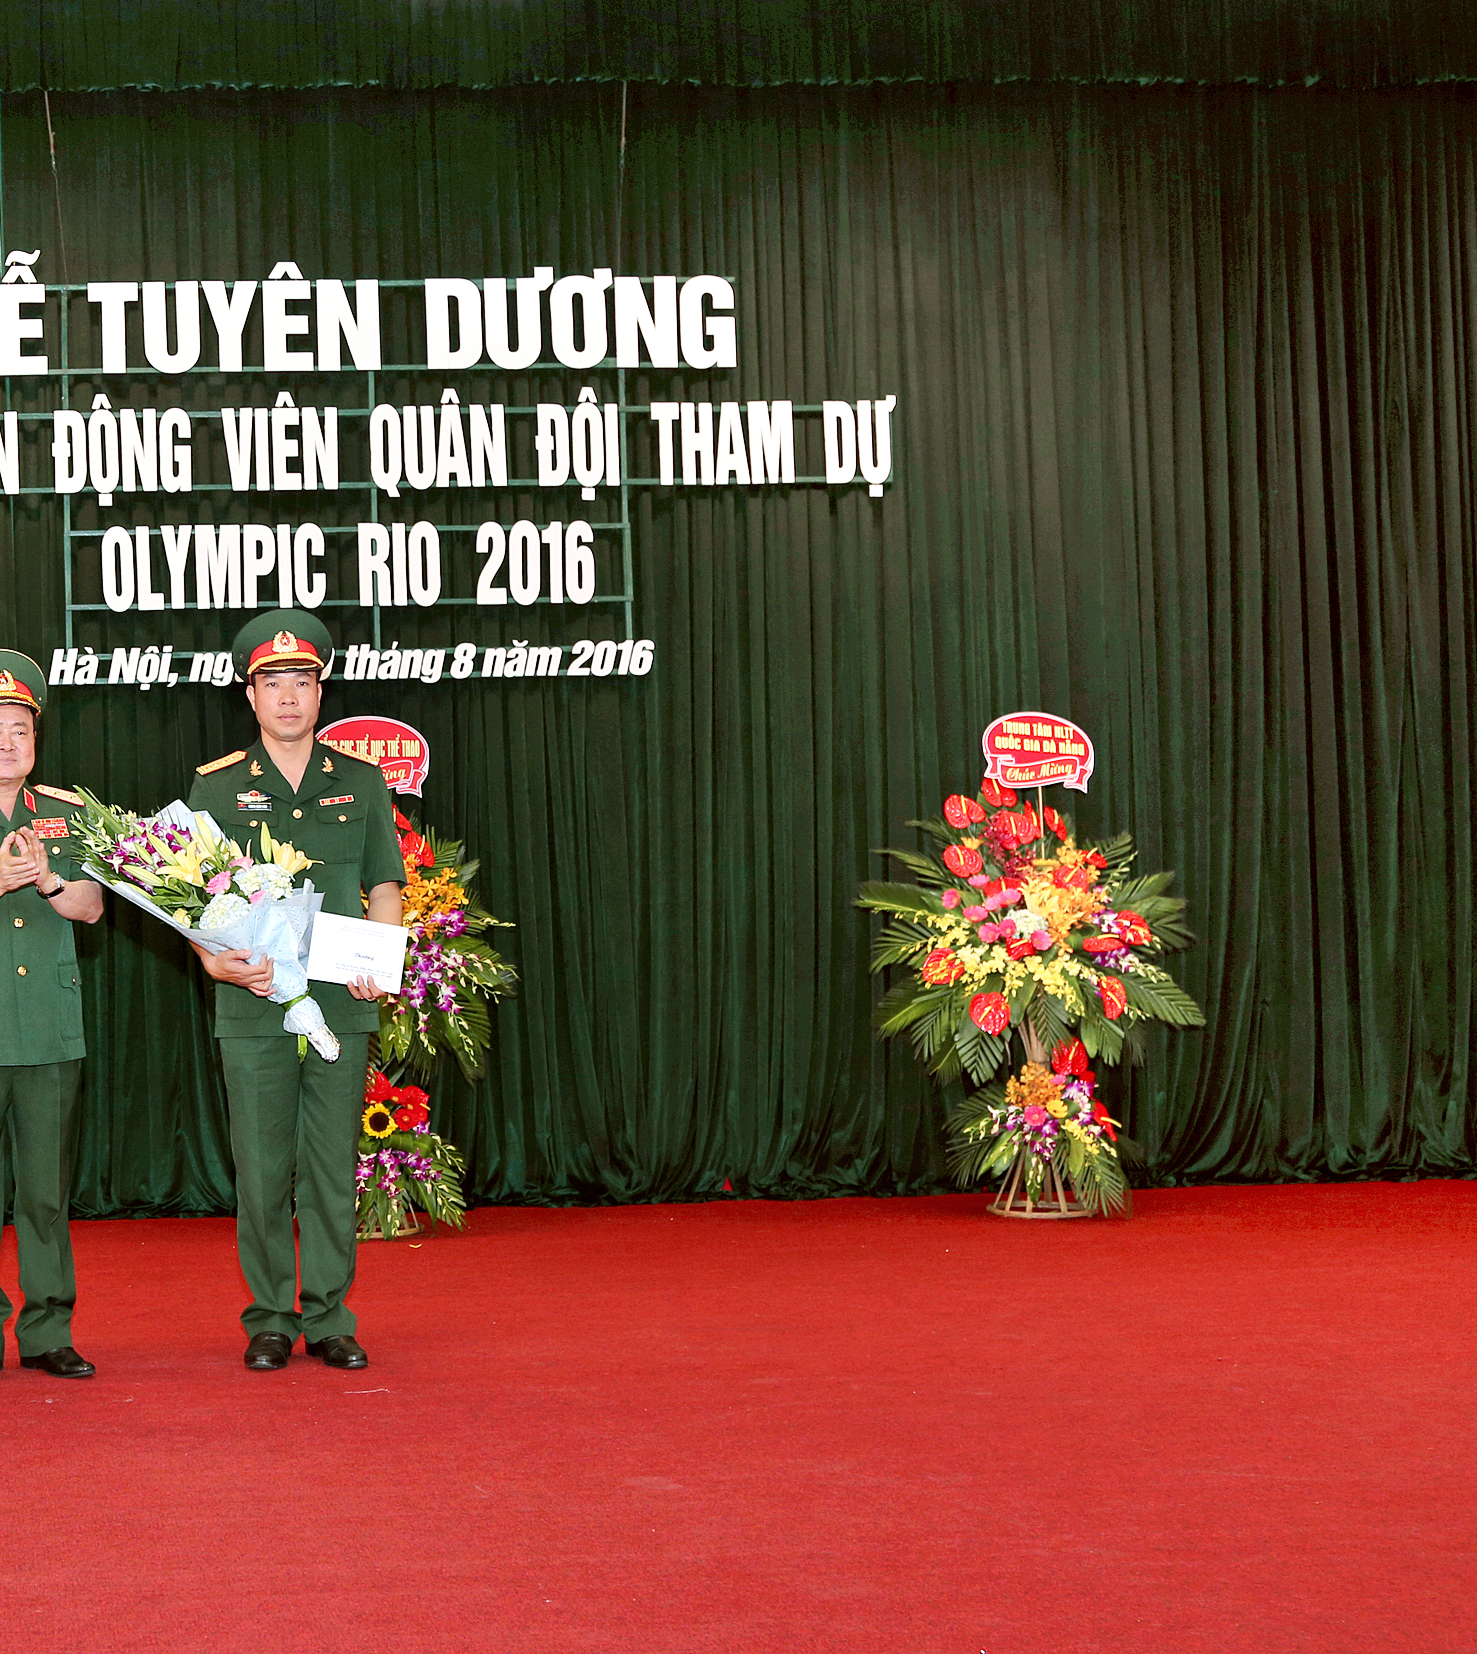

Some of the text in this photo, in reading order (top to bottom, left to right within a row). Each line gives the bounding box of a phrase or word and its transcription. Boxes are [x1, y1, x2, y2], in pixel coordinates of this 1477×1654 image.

[87, 261, 381, 374] TUYÊN
[425, 266, 737, 369] DƯƠNG
[52, 393, 192, 506] ĐỘNG
[221, 391, 339, 491] VIÊN
[369, 388, 508, 498] QUÂN
[535, 386, 621, 500] ĐỘI
[650, 400, 795, 485] THAM
[824, 395, 896, 497] DỰ
[101, 520, 596, 612] OLYMPIC RIO 2016
[48, 646, 99, 685] Hà
[107, 645, 178, 691] Nội,
[188, 652, 245, 687] ng
[343, 640, 445, 684] tháng
[450, 643, 476, 678] 8
[481, 638, 562, 677] năm
[567, 639, 656, 677] 2016
[387, 734, 400, 758] THỂ
[401, 739, 421, 758] THAO
[1002, 721, 1074, 739] TRUNG TÂM HLTT
[1023, 739, 1041, 752] GIA
[1006, 767, 1037, 782] Chúc
